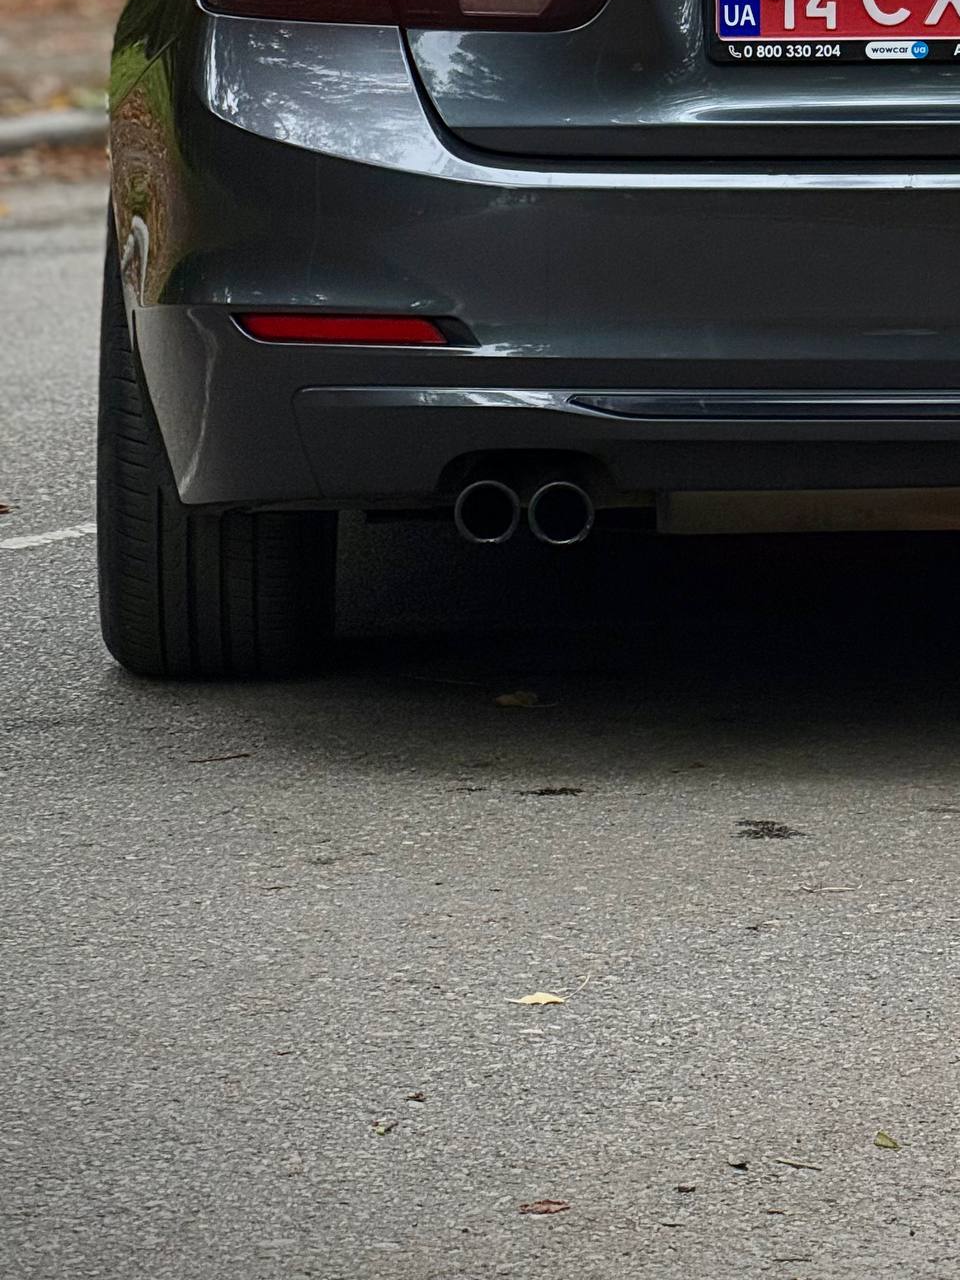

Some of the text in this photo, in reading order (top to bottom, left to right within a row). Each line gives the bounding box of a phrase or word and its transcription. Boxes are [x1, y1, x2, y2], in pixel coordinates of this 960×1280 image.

[723, 4, 756, 27] UA
[743, 45, 841, 58] 0 800 330 204
[871, 45, 908, 54] wowcar
